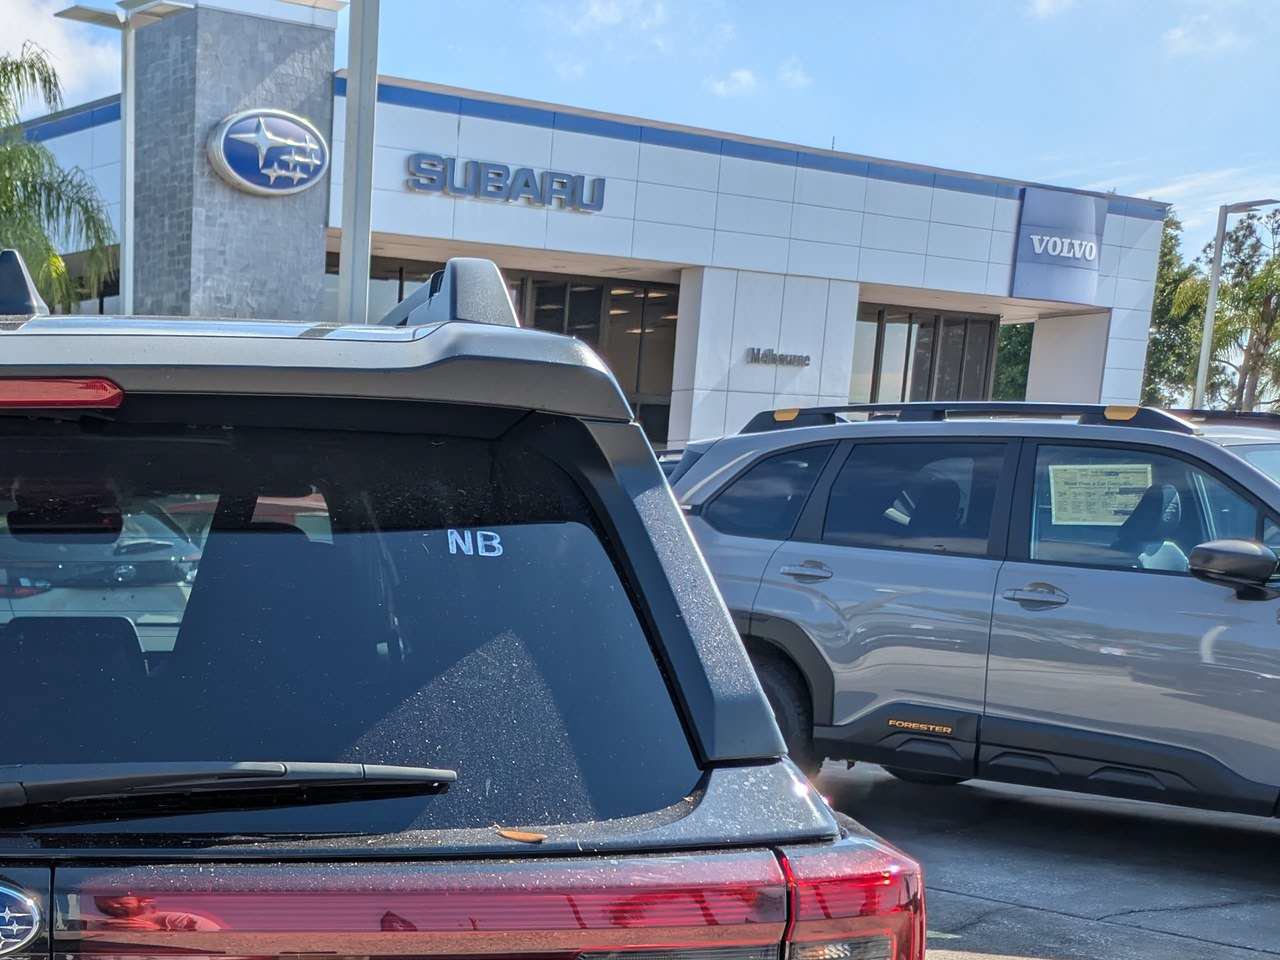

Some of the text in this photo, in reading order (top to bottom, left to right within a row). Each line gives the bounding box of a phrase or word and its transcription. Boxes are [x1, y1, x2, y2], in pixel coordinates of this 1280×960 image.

[407, 152, 606, 213] SUBARU
[1030, 234, 1097, 261] VOLVO
[746, 347, 811, 367] Melbourne
[447, 528, 504, 557] NB
[888, 719, 952, 734] FORESTER
